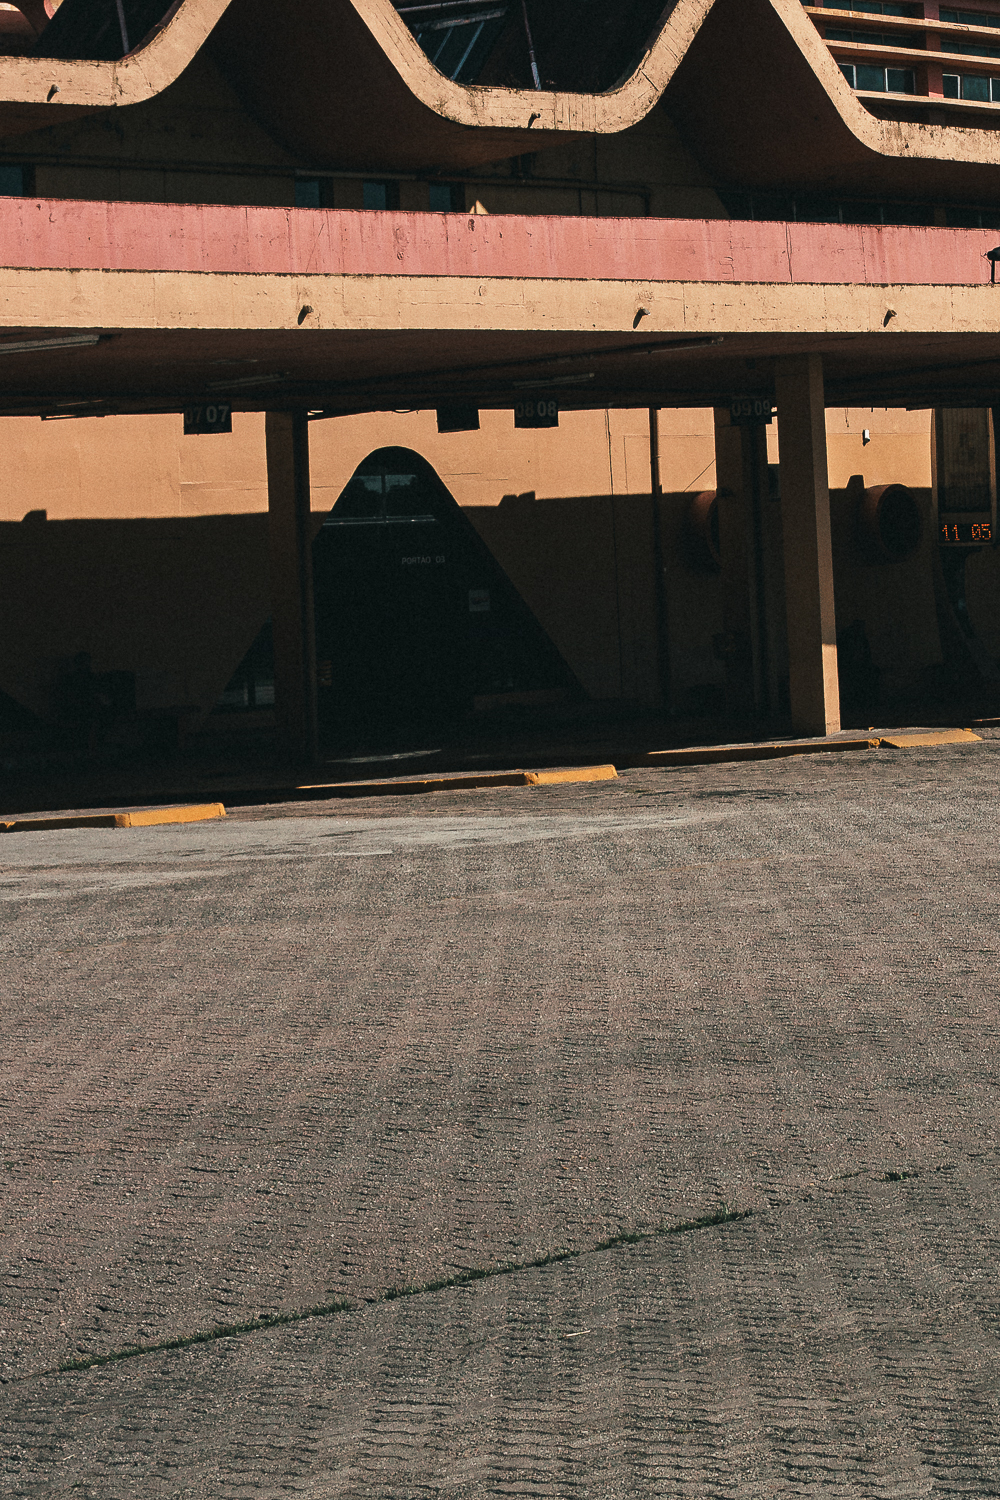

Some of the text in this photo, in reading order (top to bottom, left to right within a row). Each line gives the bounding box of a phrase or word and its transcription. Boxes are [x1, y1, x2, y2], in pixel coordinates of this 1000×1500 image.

[206, 405, 229, 423] 07
[537, 401, 557, 417] 08
[754, 399, 771, 416] 09
[941, 523, 992, 541] 11 05
[435, 555, 446, 564] 03
